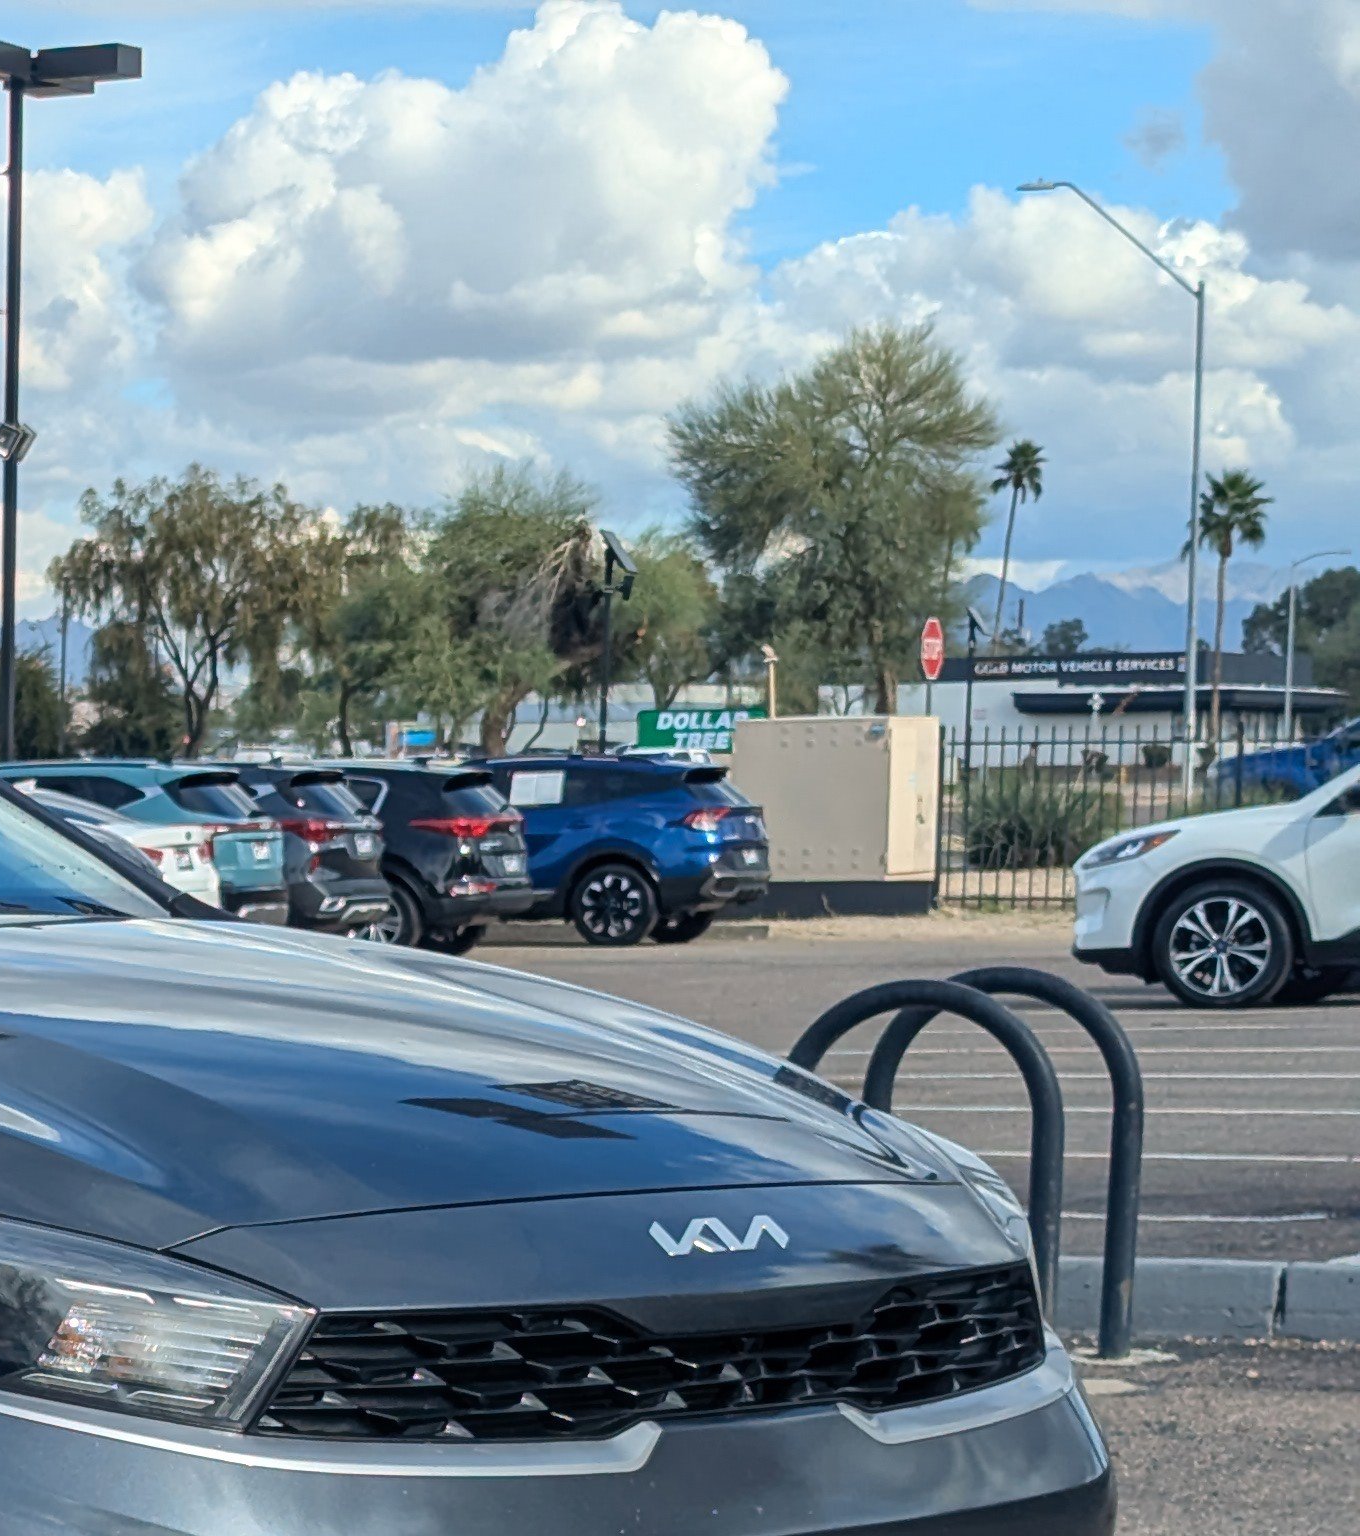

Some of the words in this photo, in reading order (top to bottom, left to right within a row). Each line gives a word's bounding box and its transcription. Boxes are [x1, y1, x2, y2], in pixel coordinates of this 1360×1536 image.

[1011, 660, 1057, 674] MOTOR
[1060, 659, 1113, 673] VEHICLE
[1115, 657, 1175, 672] SERVICES
[673, 732, 730, 750] TREE
[648, 1214, 790, 1257] KIA
